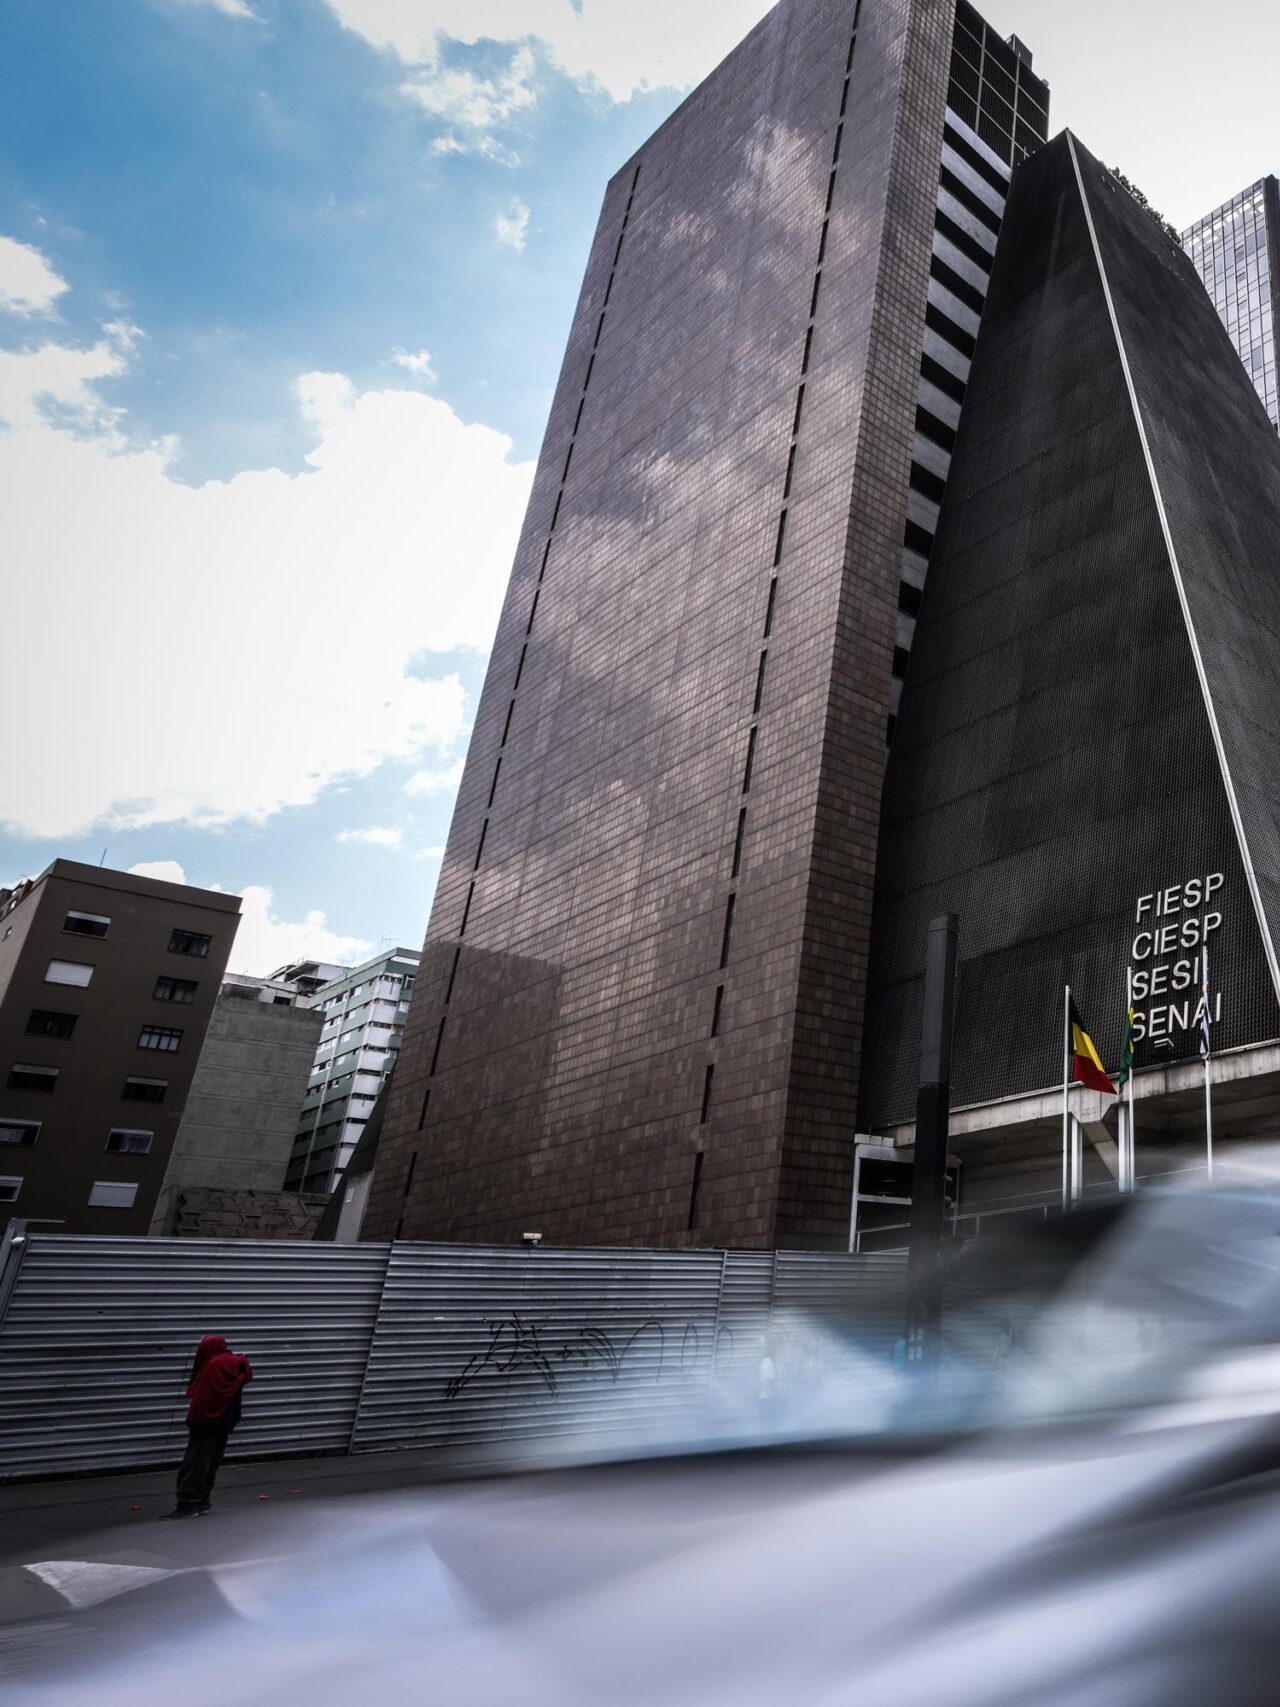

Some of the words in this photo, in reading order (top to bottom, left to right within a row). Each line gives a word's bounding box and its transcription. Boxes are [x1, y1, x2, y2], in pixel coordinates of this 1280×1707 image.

[1136, 873, 1224, 923] FIESP
[1132, 912, 1222, 960] CIESP
[1132, 956, 1199, 1001] SESI
[1132, 992, 1221, 1042] SENAI
